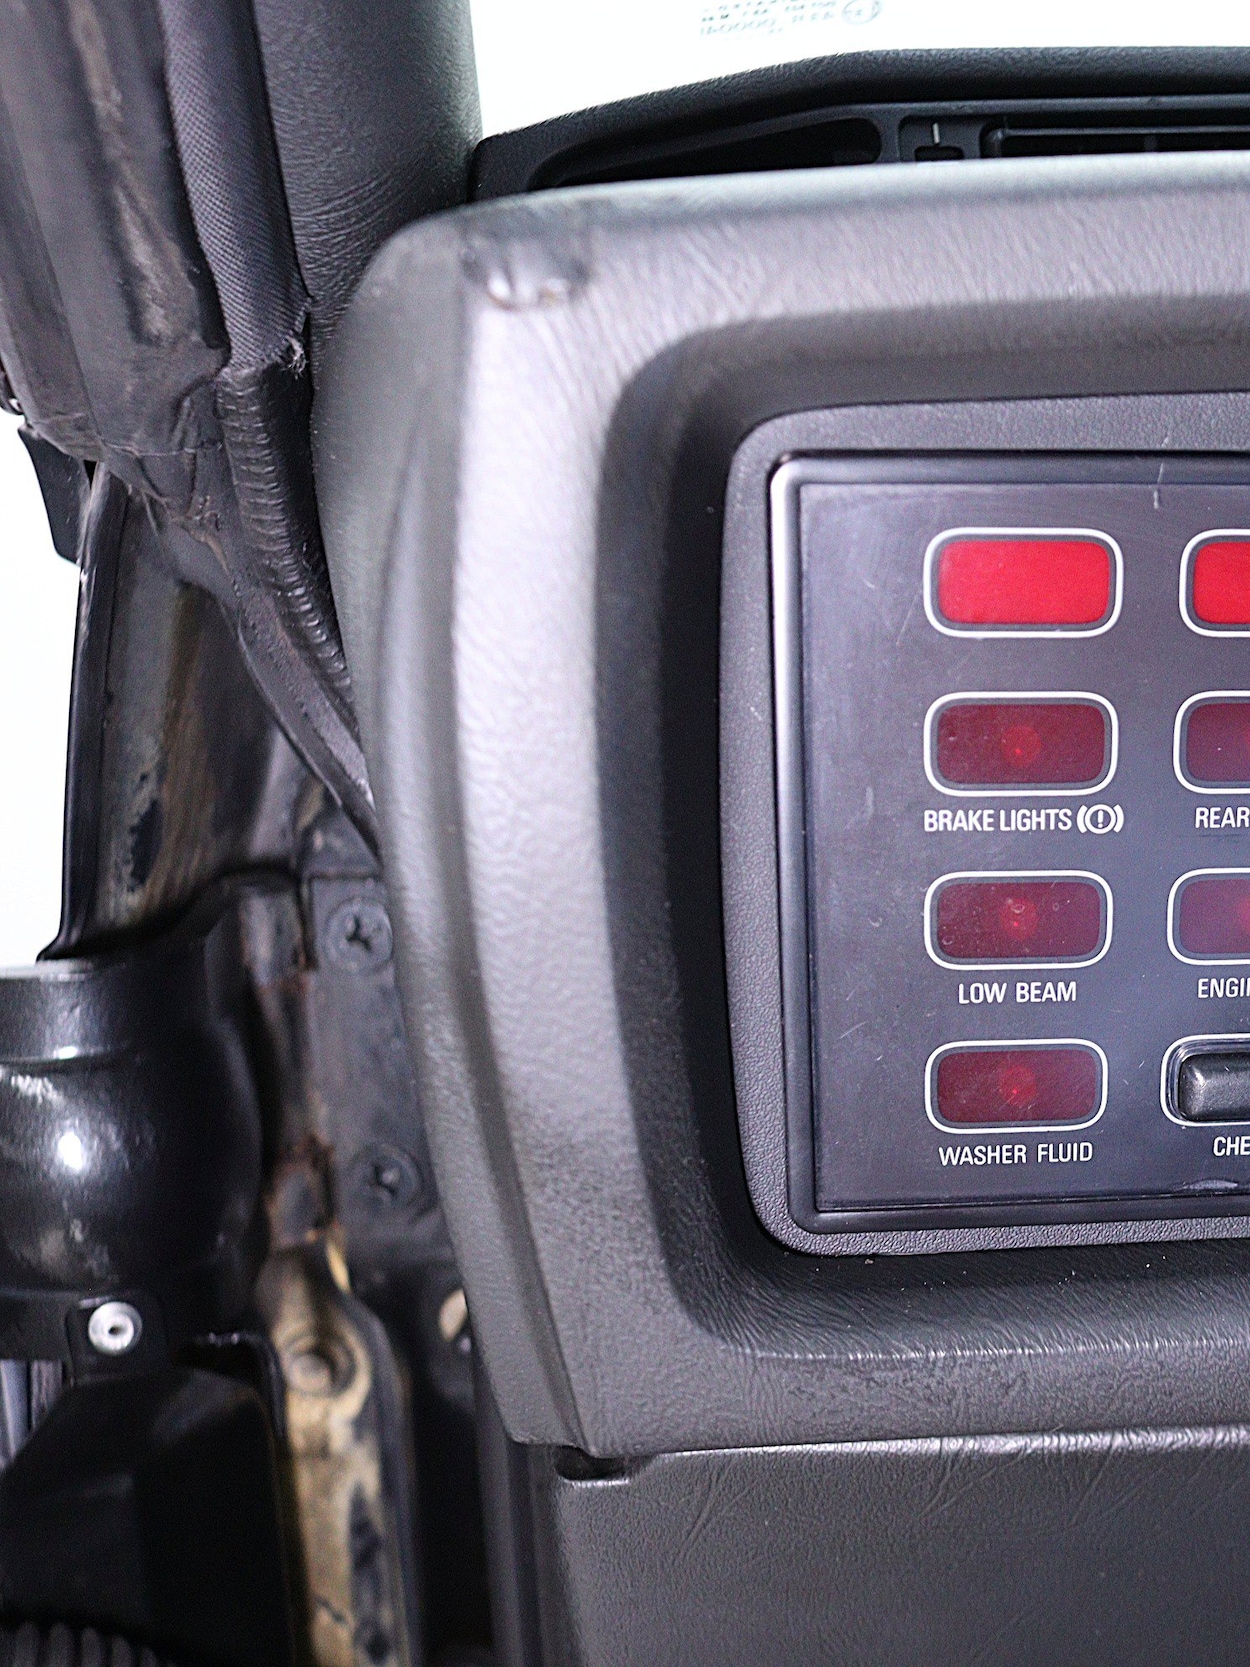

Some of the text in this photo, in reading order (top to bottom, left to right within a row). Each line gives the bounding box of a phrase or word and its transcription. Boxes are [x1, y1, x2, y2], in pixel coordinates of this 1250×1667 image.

[924, 807, 1072, 832] BRAKE LIGHTS
[1195, 806, 1250, 829] REAR
[958, 981, 1077, 1004] LOW BEAM
[939, 1142, 1093, 1166] WASHER FLUID
